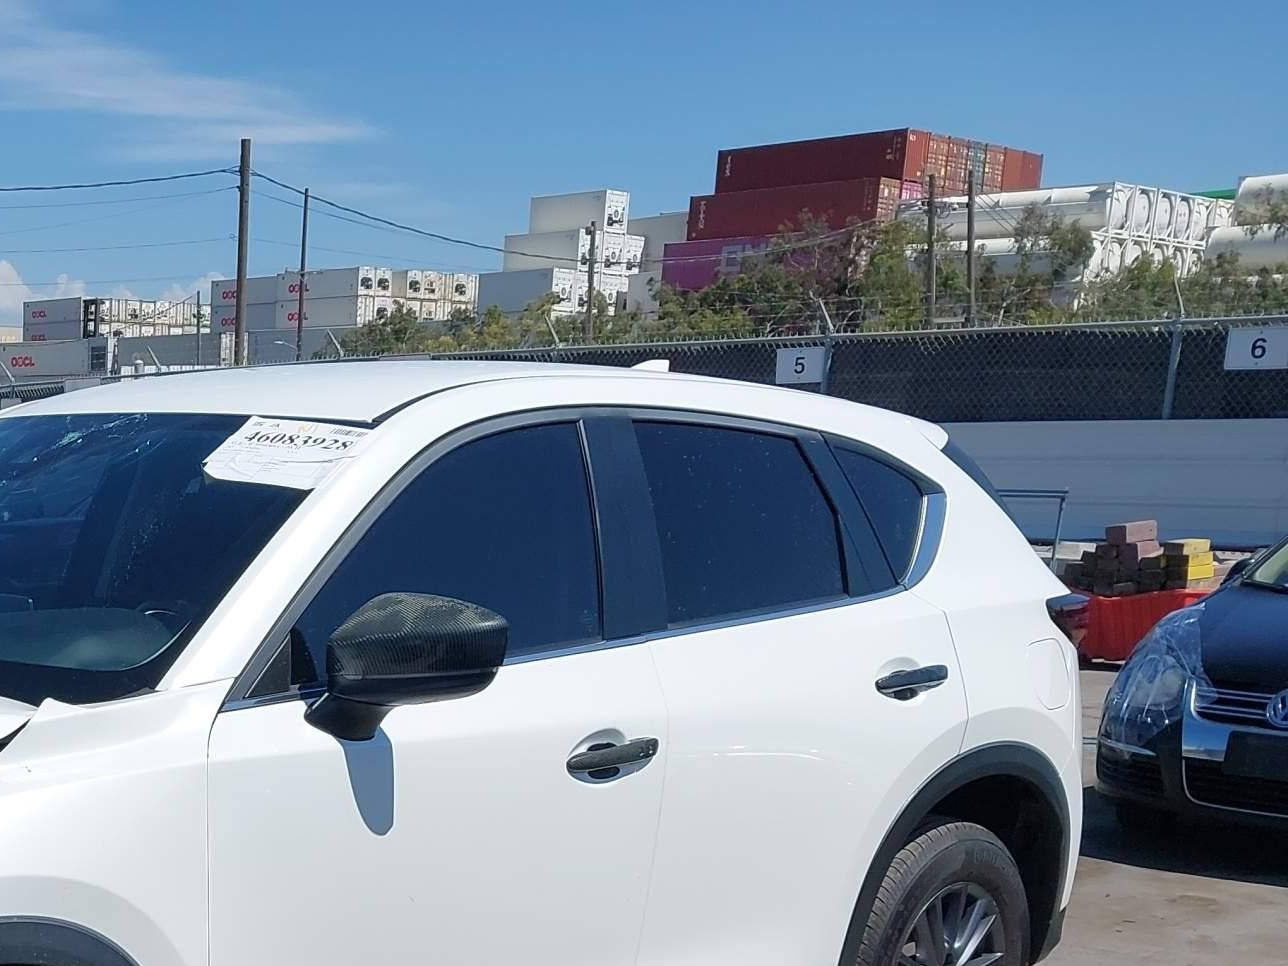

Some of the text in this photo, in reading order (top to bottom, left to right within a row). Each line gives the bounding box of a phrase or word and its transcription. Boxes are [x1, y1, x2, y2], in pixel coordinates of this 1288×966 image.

[1250, 337, 1268, 359] 6
[11, 356, 35, 368] OOCL
[794, 356, 806, 374] 5
[244, 430, 354, 451] 46083928
